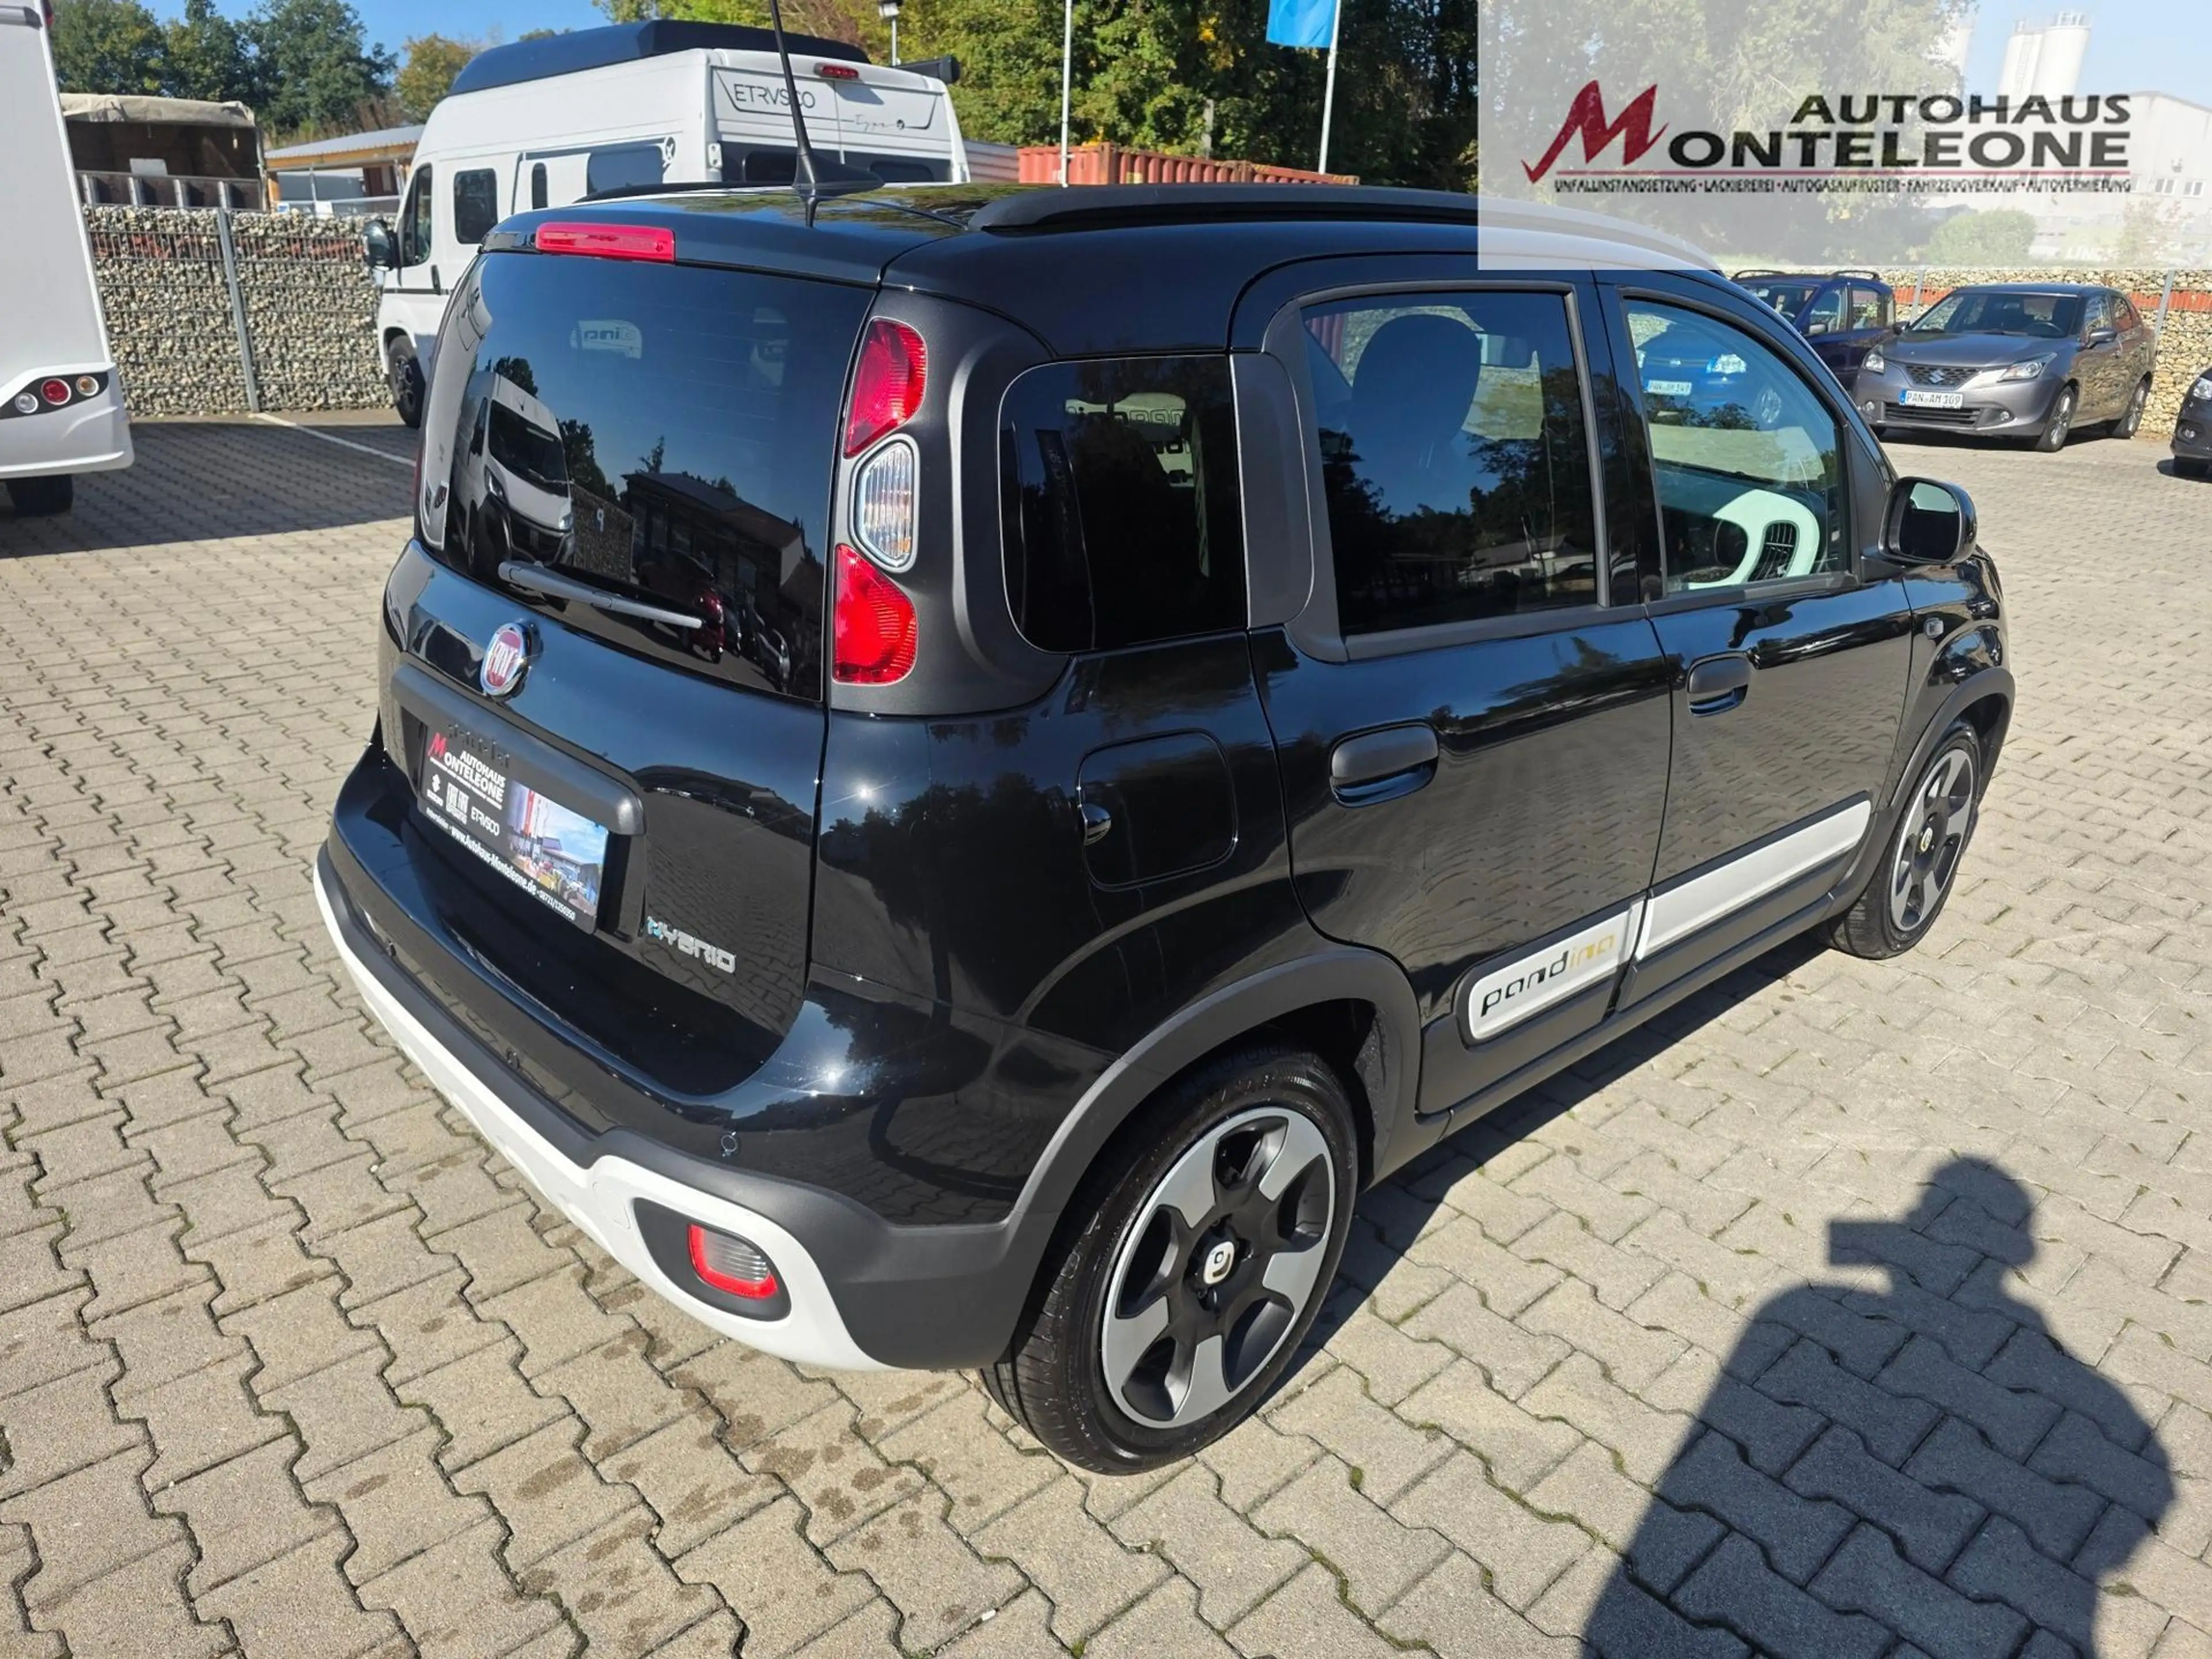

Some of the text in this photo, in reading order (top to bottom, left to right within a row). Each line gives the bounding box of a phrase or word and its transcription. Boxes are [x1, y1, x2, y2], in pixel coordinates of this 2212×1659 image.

[427, 732, 505, 803] MONTELEONE
[460, 751, 506, 789] AUTOHAUS
[647, 915, 737, 974] HYBRID
[1480, 933, 1616, 1017] pandina
